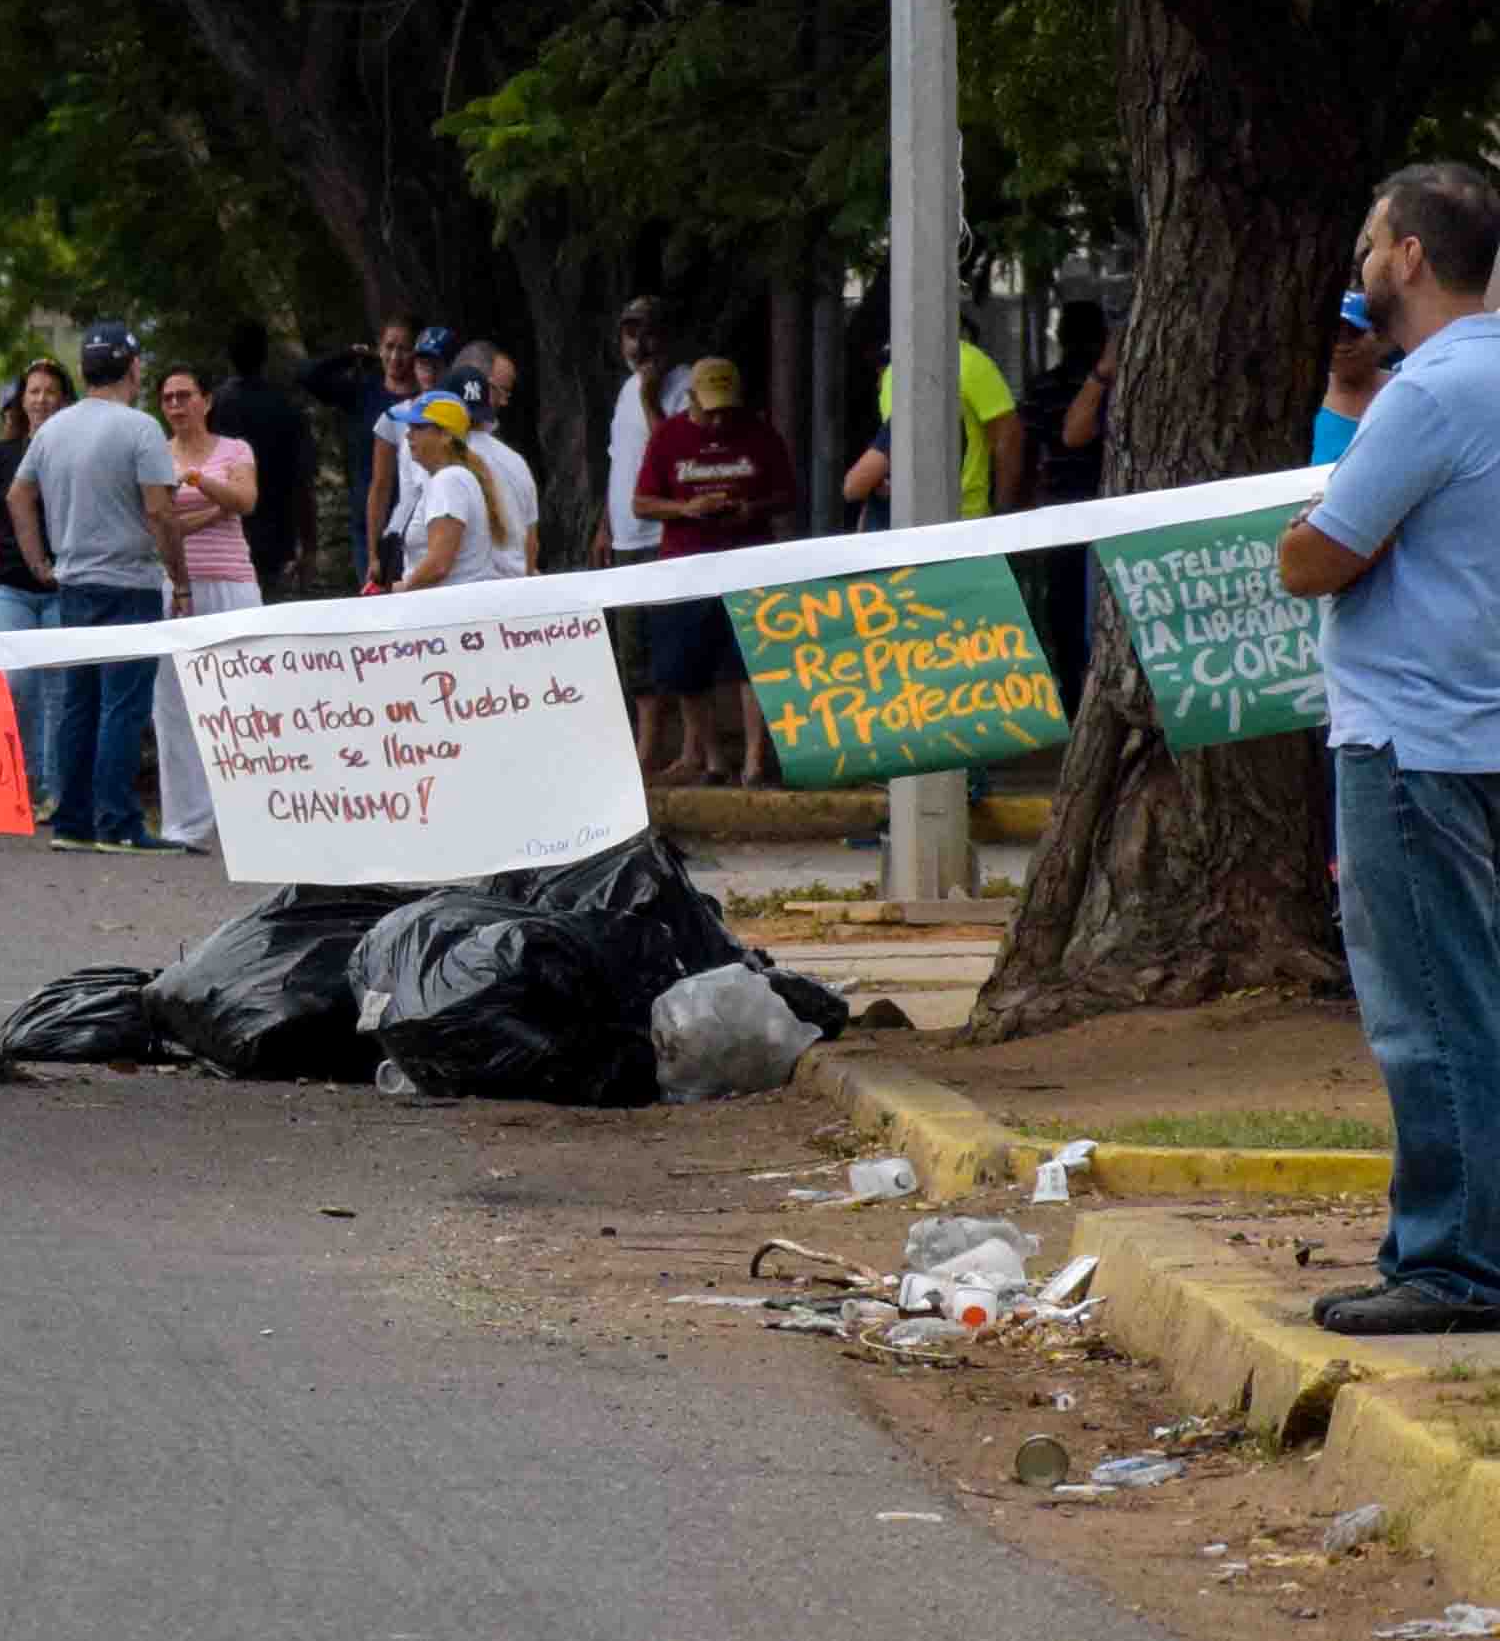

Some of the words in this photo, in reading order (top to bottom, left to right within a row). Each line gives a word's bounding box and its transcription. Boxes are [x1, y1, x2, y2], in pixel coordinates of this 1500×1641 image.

[756, 582, 899, 640] GNB
[1129, 587, 1175, 623] EN
[188, 650, 276, 701] Matar
[302, 650, 345, 672] una
[351, 641, 448, 683] persona
[460, 631, 486, 651] es
[499, 616, 602, 651] homicidio
[1140, 620, 1182, 661] LA
[1193, 630, 1320, 687] CORA
[199, 705, 285, 752] Matar
[386, 700, 426, 723] un
[543, 676, 584, 705] de
[213, 743, 313, 782] Hambre
[339, 747, 370, 768] se
